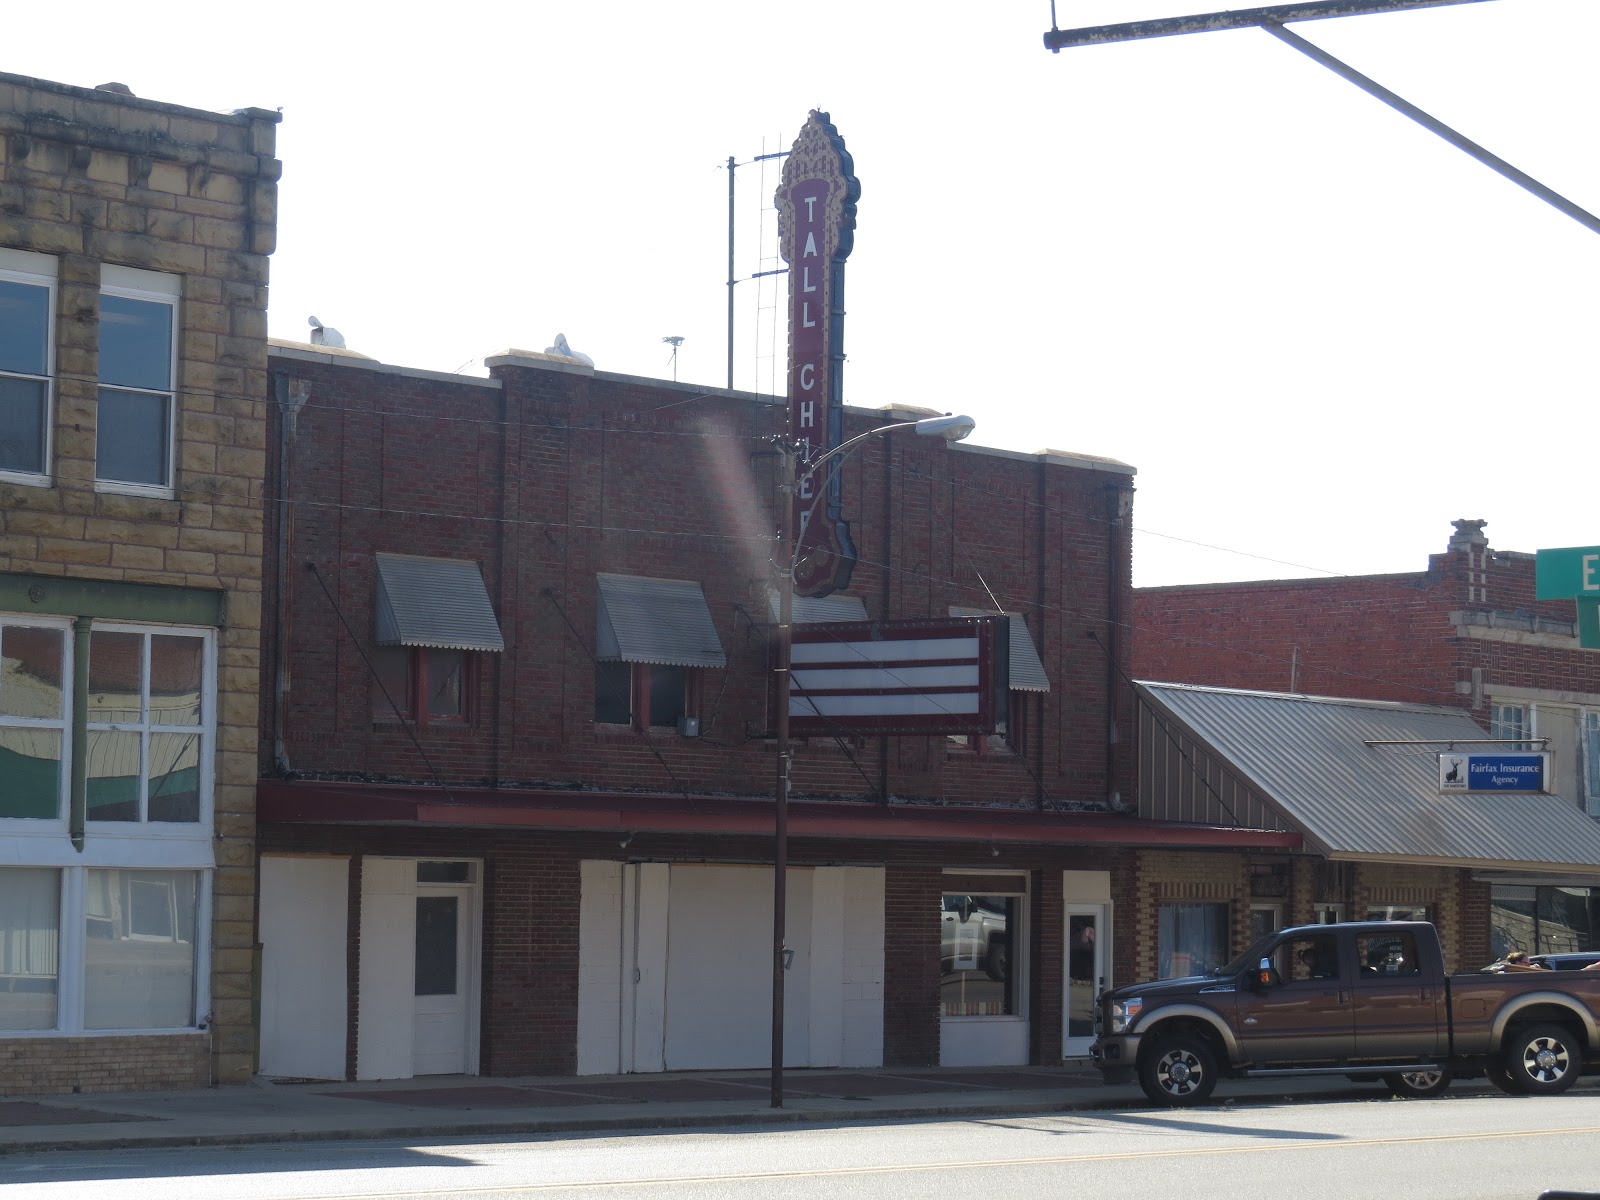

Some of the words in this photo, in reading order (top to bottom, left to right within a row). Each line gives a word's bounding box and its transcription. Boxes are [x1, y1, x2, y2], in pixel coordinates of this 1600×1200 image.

[803, 197, 817, 329] TALL
[1470, 763, 1498, 773] Fairfax
[1500, 763, 1540, 773] Insurance
[1491, 775, 1518, 785] Agency
